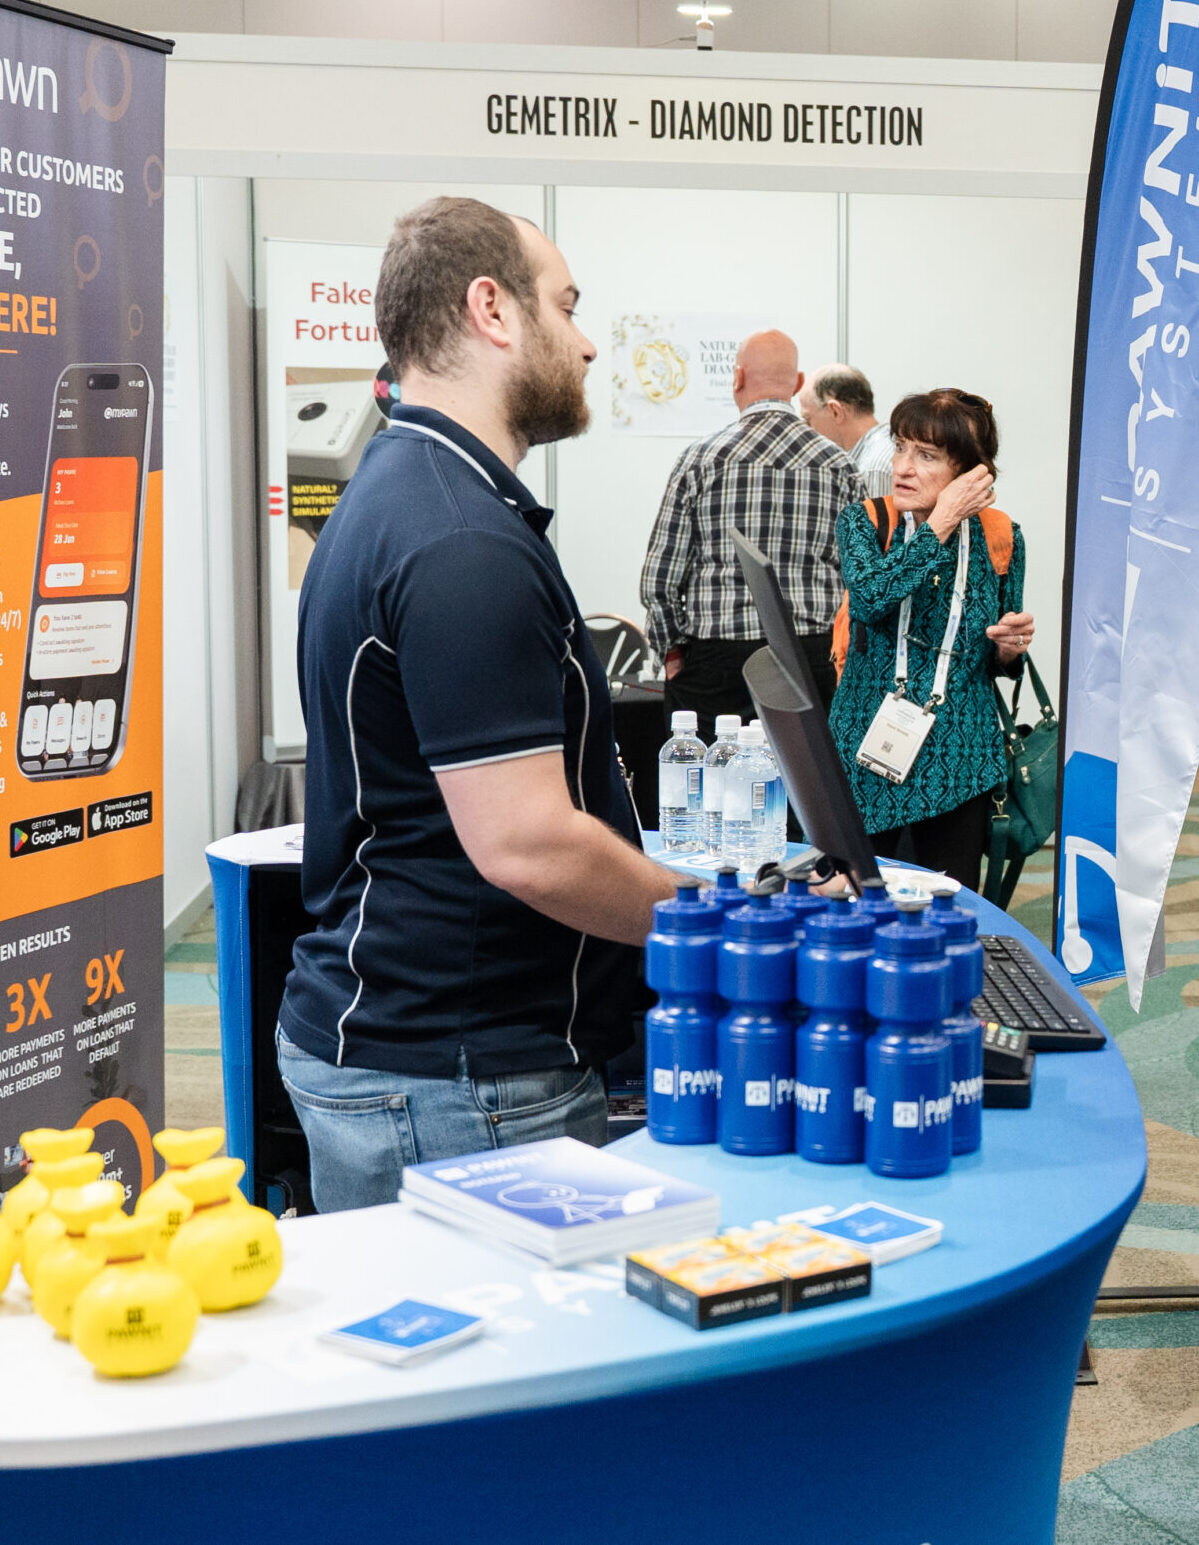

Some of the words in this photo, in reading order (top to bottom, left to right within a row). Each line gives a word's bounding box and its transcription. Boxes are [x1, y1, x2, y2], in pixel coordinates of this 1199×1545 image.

[0, 57, 58, 114] wn
[486, 93, 618, 137] GEMETRIX
[650, 99, 773, 142] DIAMOND
[782, 103, 924, 146] DETECTION
[16, 150, 125, 194] CUSTOMERS
[310, 281, 373, 306] Fake
[31, 827, 63, 845] Google
[63, 824, 81, 838] Play
[104, 814, 124, 829] App
[125, 808, 149, 824] Store
[19, 925, 71, 954] RESULTS
[85, 948, 125, 1006] 9X
[6, 973, 53, 1033] 3X
[73, 1017, 97, 1036] MORE
[97, 1002, 137, 1026] PAYMENTS
[0, 1045, 20, 1063] ORE
[20, 1029, 66, 1056] PAYMENTS
[76, 1036, 89, 1052] ON
[90, 1026, 115, 1046] LOANS
[114, 1018, 135, 1036] THAT
[10, 1055, 39, 1078] LOANS
[41, 1046, 64, 1065] THAT
[89, 1041, 120, 1064] DEFAULT
[15, 1065, 62, 1093] REDEEMED
